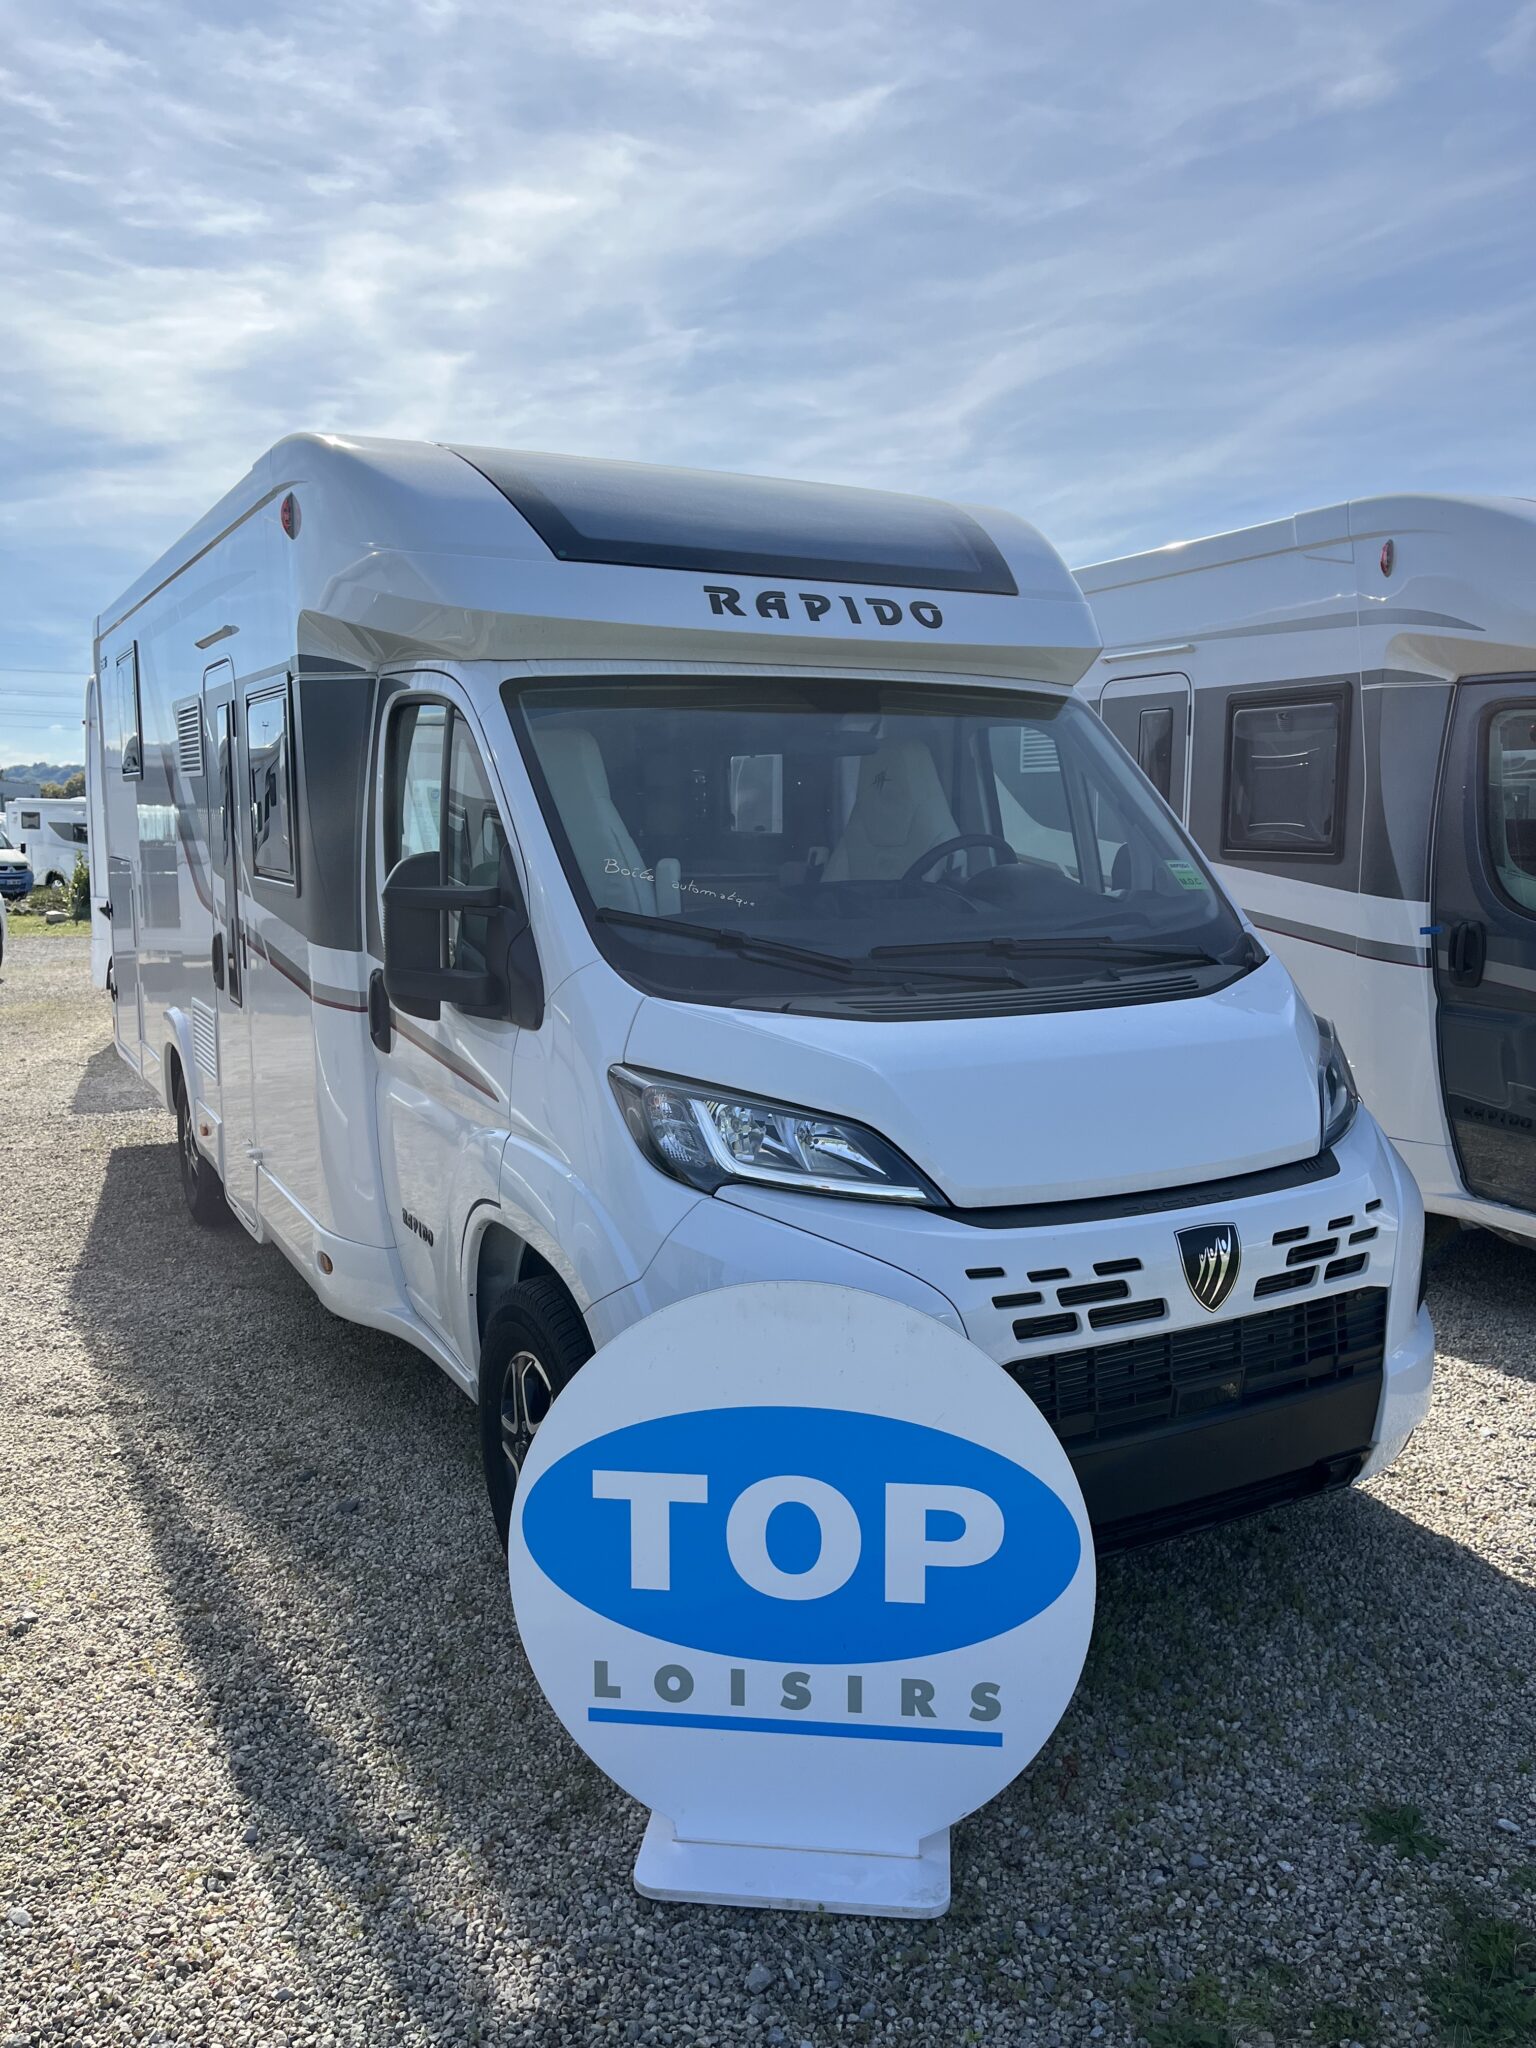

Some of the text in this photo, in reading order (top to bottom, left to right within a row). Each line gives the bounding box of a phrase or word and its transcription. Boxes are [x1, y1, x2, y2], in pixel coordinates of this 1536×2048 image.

[703, 585, 944, 630] RAPIDO
[592, 1469, 1006, 1604] TOP
[593, 1659, 1003, 1723] LOISIRS
